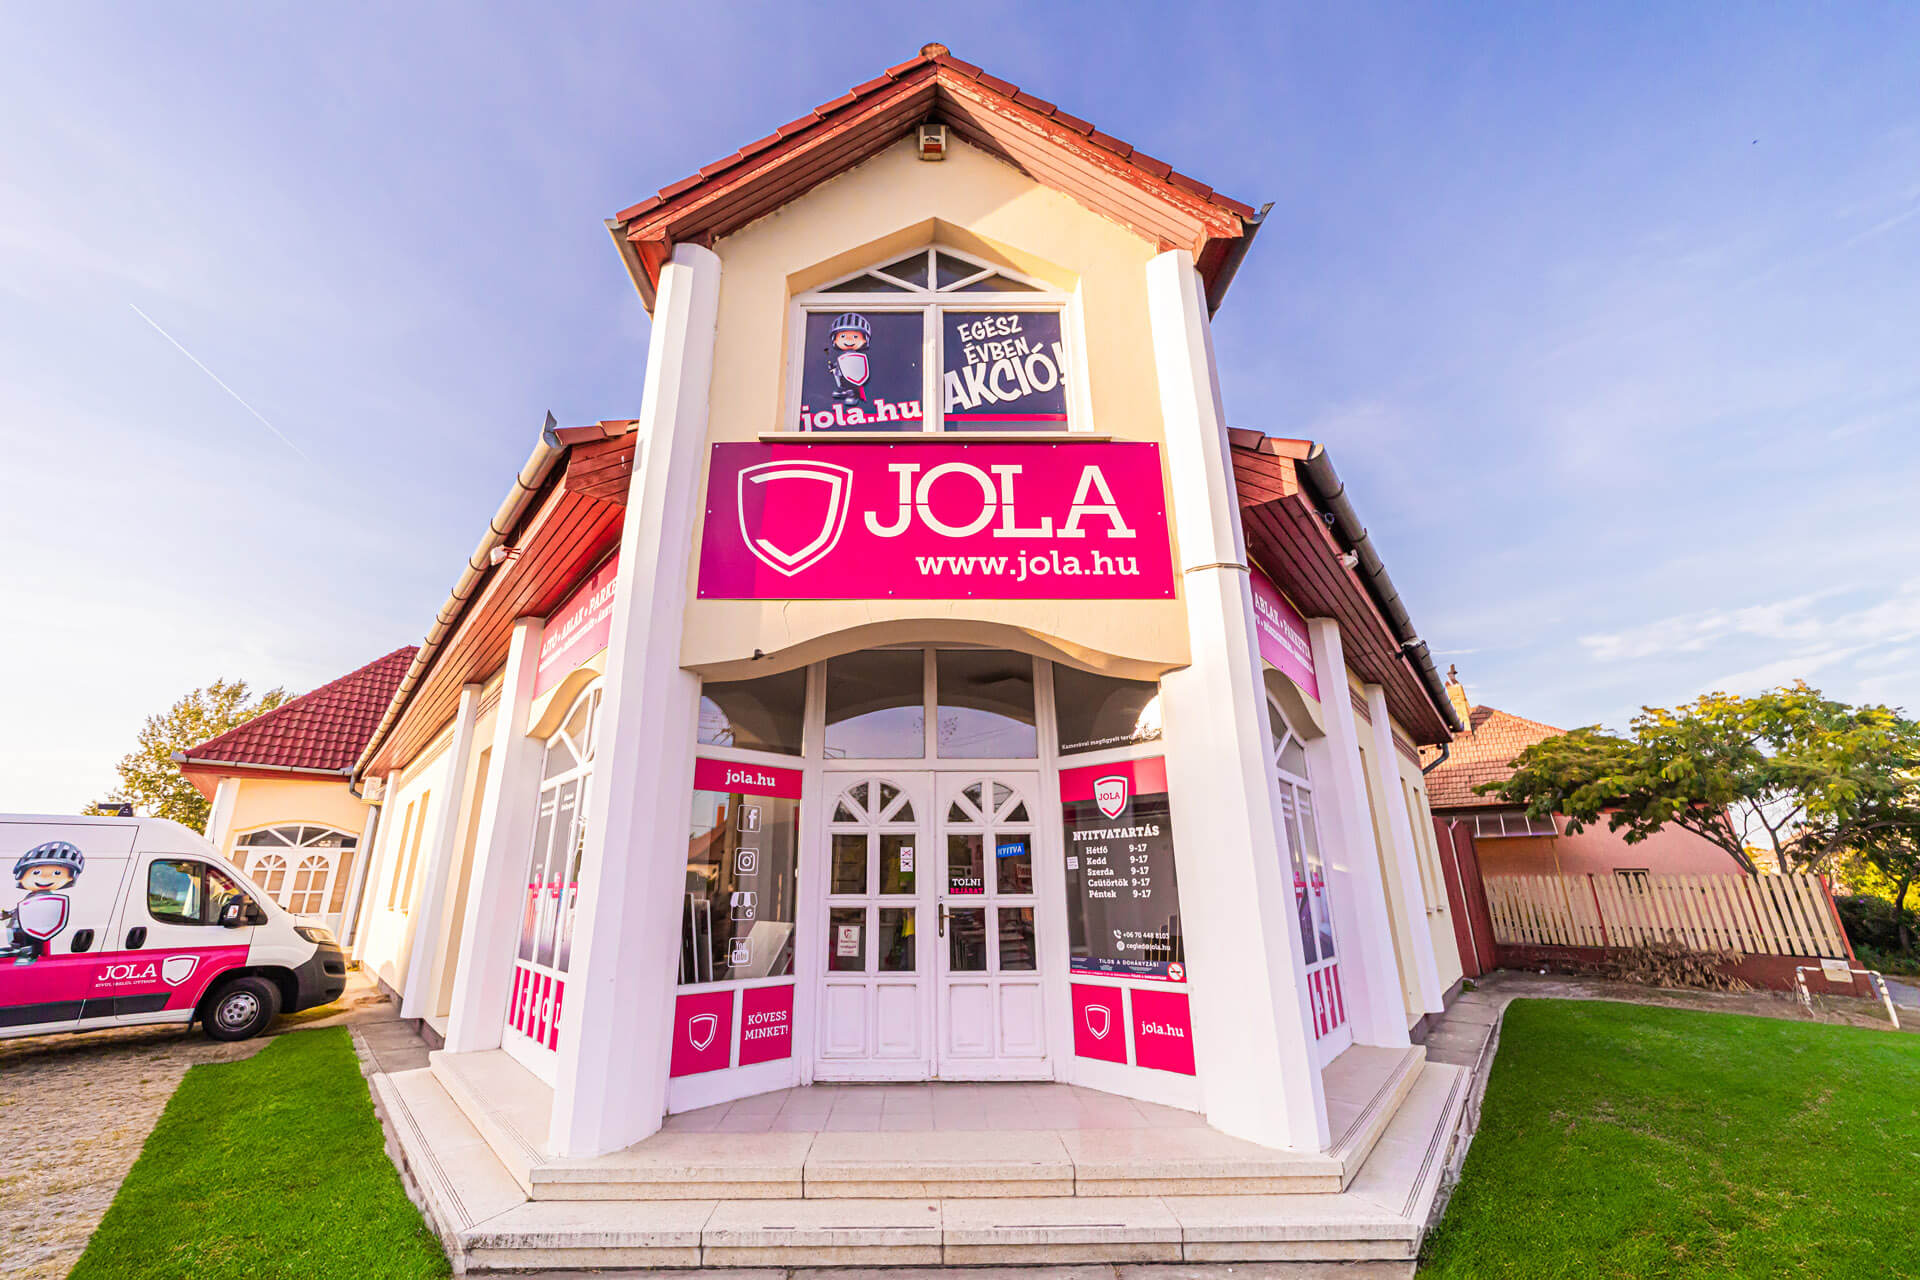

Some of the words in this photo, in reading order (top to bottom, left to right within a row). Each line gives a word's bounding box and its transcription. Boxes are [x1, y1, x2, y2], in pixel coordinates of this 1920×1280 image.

[957, 314, 1023, 343] EGÉSZ
[964, 336, 1034, 366] ÉVBEN
[944, 341, 1066, 413] AKCIÓ!
[801, 398, 923, 432] jola.hu
[864, 462, 1136, 538] JOLA
[915, 550, 1140, 582] www.jola.hu
[725, 769, 776, 787] jola.hu
[1098, 792, 1121, 801] JOLA
[1073, 825, 1160, 841] NYITVATARTÁS
[997, 845, 1022, 856] NYITVA
[1128, 843, 1148, 852] 9-17
[1086, 856, 1107, 866] Kedd
[1129, 855, 1149, 864] 9-17
[1087, 868, 1114, 877] Szerda
[1130, 866, 1150, 875] 9-17
[952, 878, 981, 887] TOLNI
[1088, 879, 1129, 888] Csütörtök
[1131, 878, 1151, 887] 9-17
[1088, 889, 1117, 898] Péntek
[1132, 889, 1152, 898] 9-17
[98, 963, 158, 981] JOLA
[747, 1010, 788, 1025] KÖVESS
[744, 1025, 789, 1041] MINKET!
[1141, 1020, 1185, 1038] jola.hu
